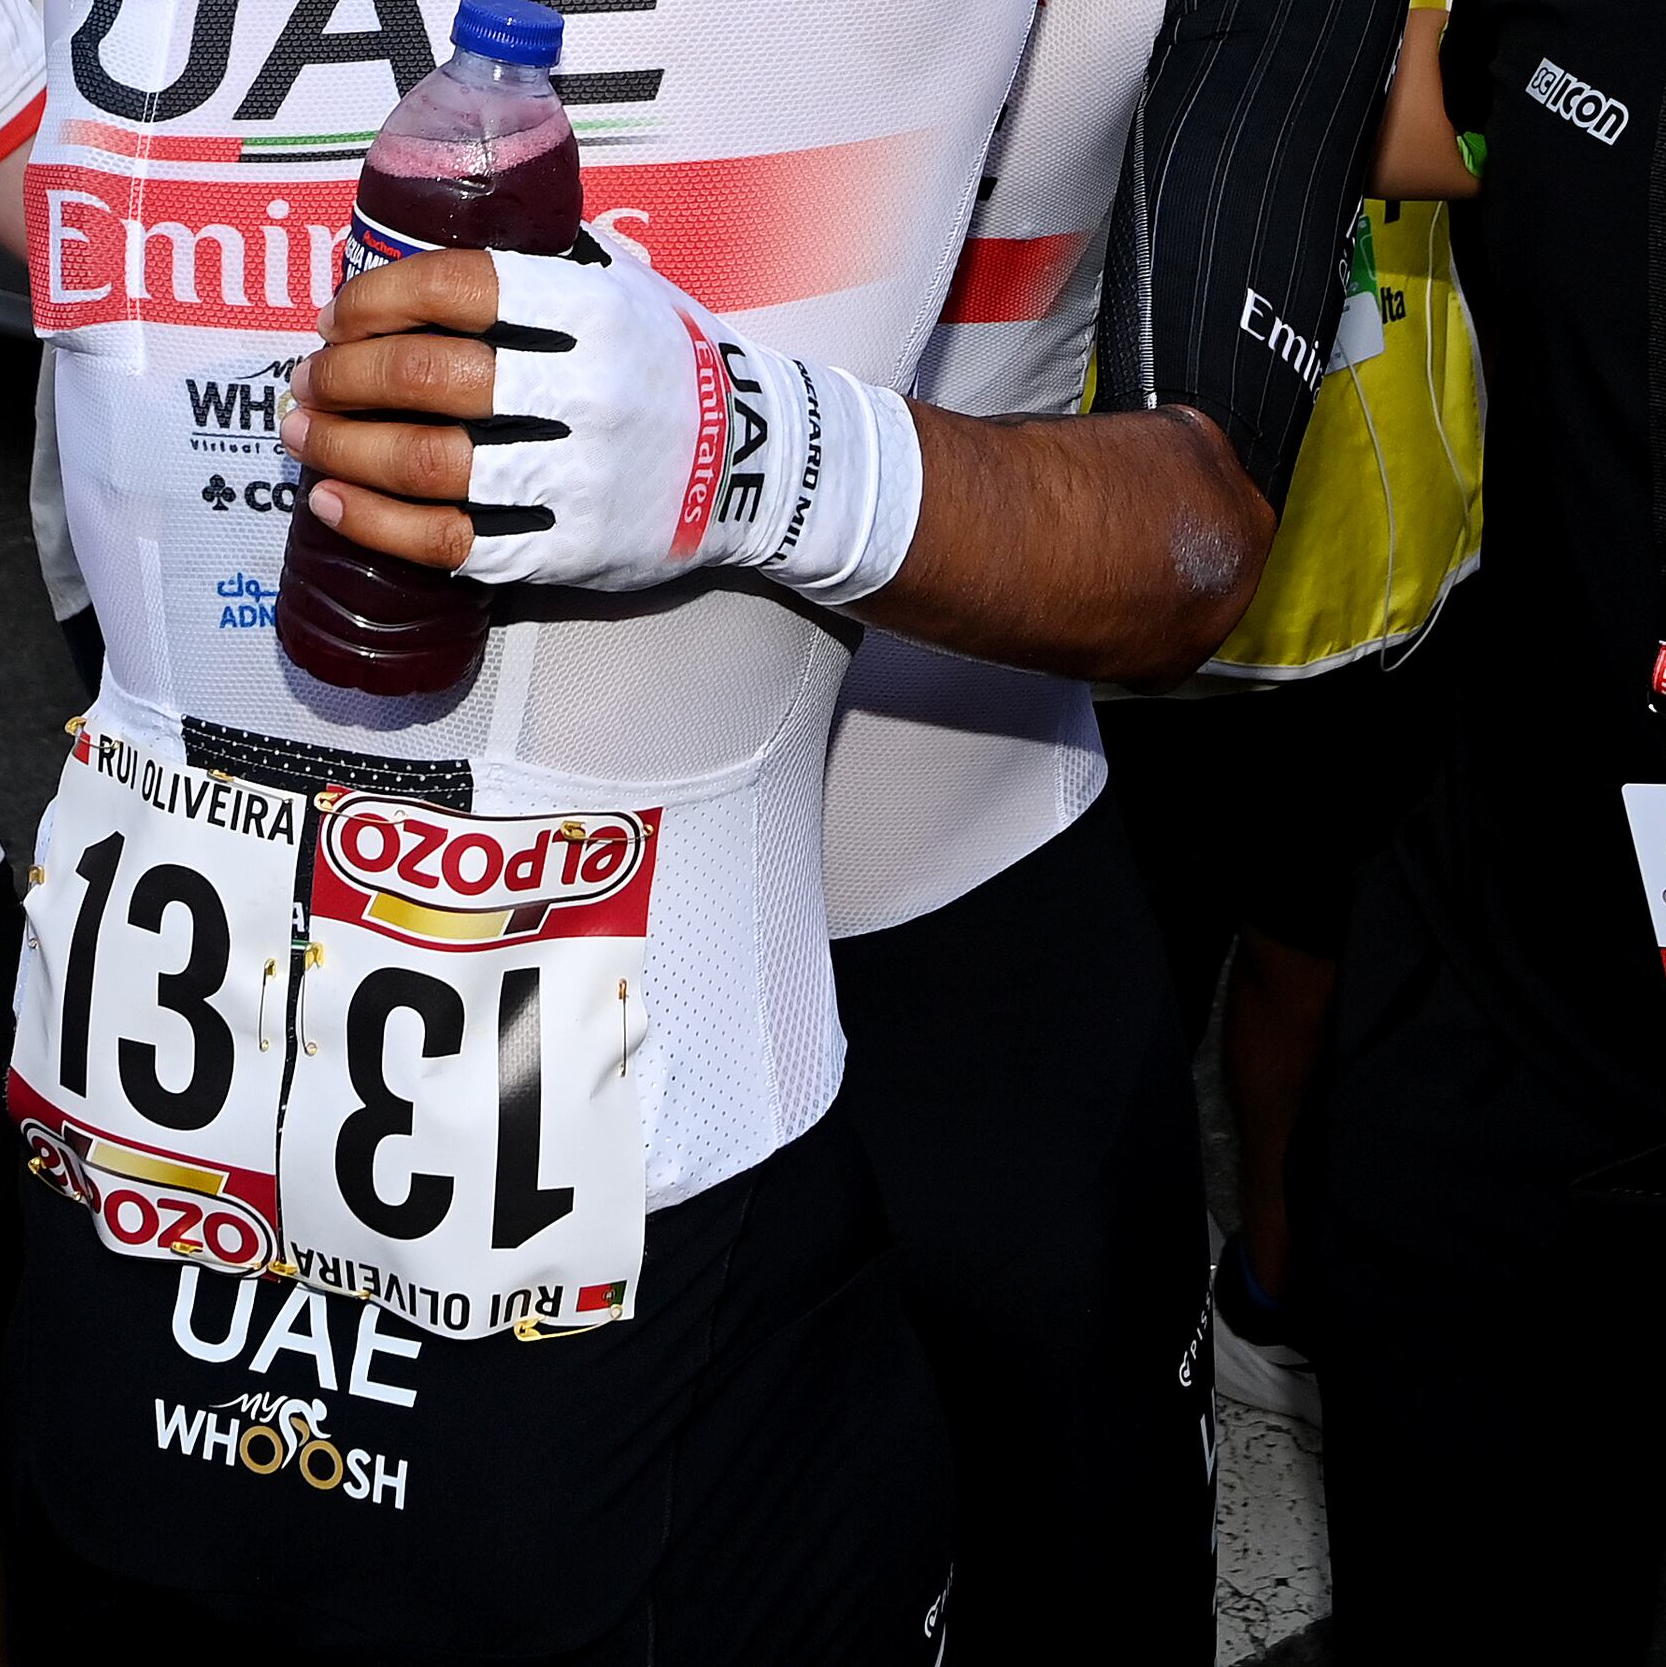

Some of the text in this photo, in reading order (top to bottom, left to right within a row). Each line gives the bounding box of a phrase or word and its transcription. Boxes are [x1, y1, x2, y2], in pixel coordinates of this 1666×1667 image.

[190, 438, 260, 454] Virtual
[684, 338, 724, 524] Emirates
[718, 342, 768, 523] UAE
[97, 734, 298, 848] RUI OLIVEIRA
[60, 830, 235, 1131] 13
[333, 965, 576, 1251] 13
[171, 1264, 423, 1408] UAE
[290, 1240, 563, 1332] RUI OLIVEIRA
[154, 1397, 409, 1511] WHOOSH
